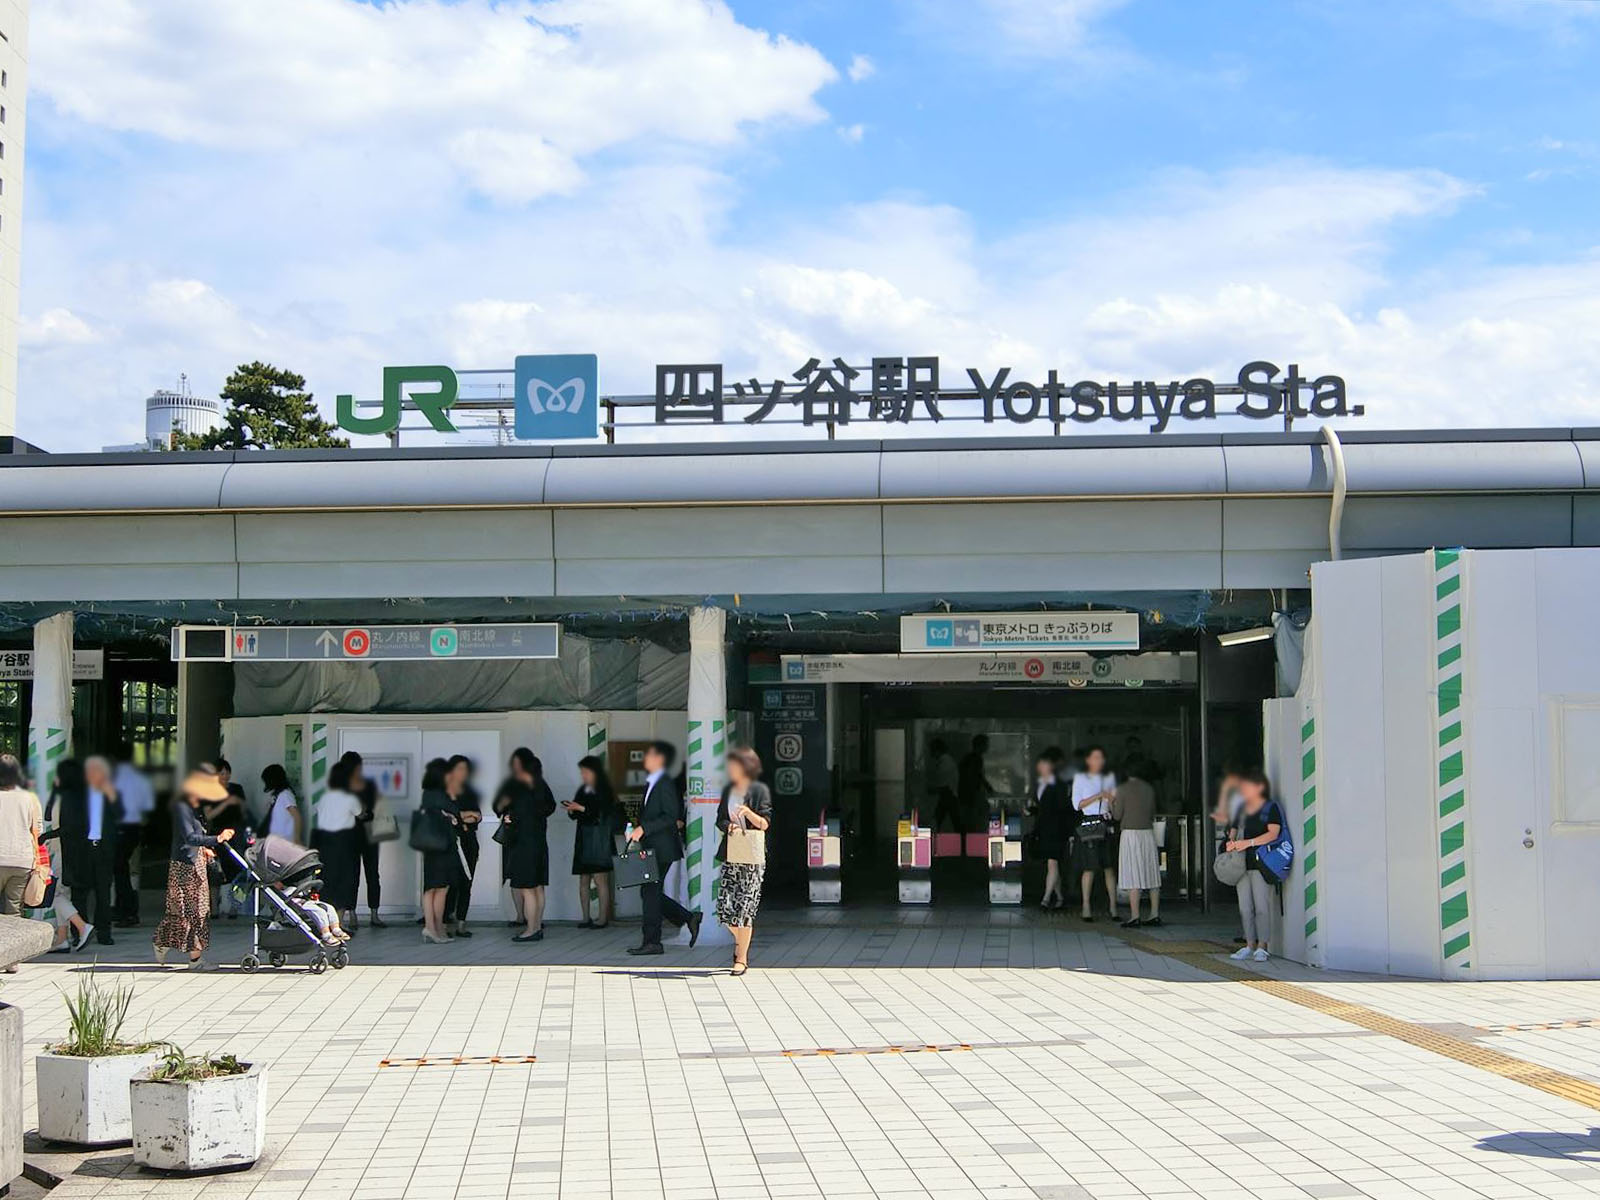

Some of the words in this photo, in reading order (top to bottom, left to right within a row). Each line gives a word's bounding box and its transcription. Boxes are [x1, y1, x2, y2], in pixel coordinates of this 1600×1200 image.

[336, 364, 460, 434] JR
[966, 366, 1216, 434] Yotsuya
[1237, 360, 1365, 419] Sta.
[459, 629, 497, 641] 南北線
[983, 623, 1039, 635] 東京メトロ
[1044, 622, 1113, 634] きっぷうりば
[372, 630, 421, 643] 丸ノ内線
[983, 635, 1002, 643] Tokyo
[979, 661, 1017, 671] 丸ノ内線
[689, 780, 703, 793] JR
